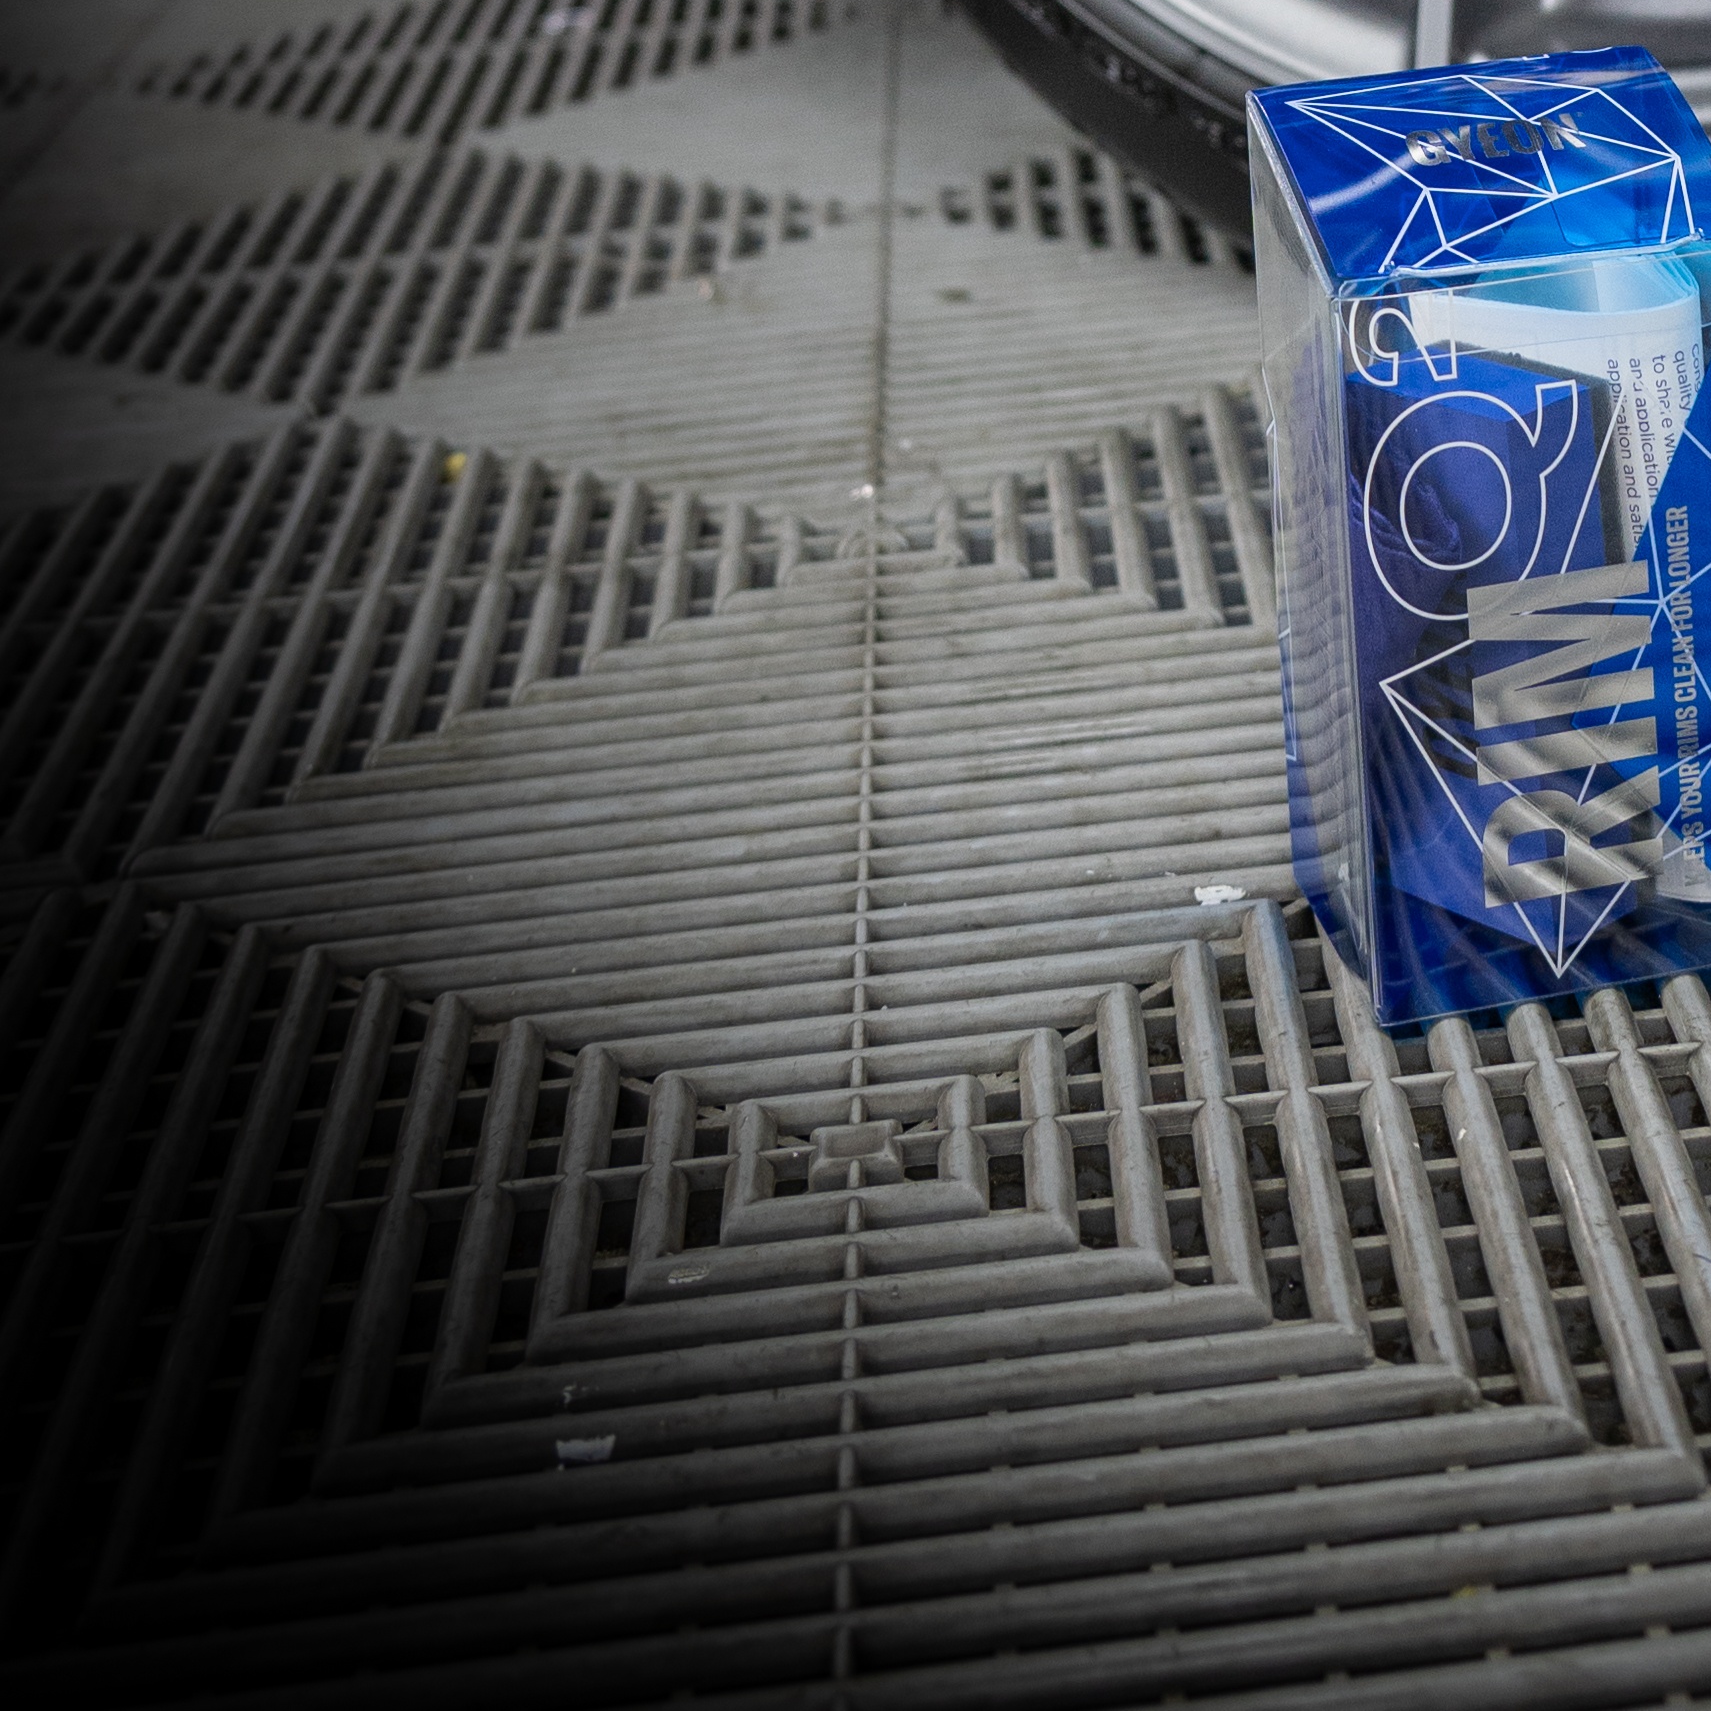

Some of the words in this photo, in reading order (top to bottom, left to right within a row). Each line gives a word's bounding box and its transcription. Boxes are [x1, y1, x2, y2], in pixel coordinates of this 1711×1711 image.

[1405, 112, 1587, 167] GYEON
[1651, 354, 1667, 373] to
[1672, 349, 1693, 412] quality
[1622, 463, 1641, 498] and
[1666, 505, 1690, 587] LONGER
[1669, 591, 1692, 632] FOR
[1671, 636, 1697, 700] CLEAN
[1466, 558, 1664, 909] RIM
[1675, 706, 1700, 756] RIMS
[1678, 762, 1703, 817] YOUR
[1682, 821, 1706, 887] KEPS
